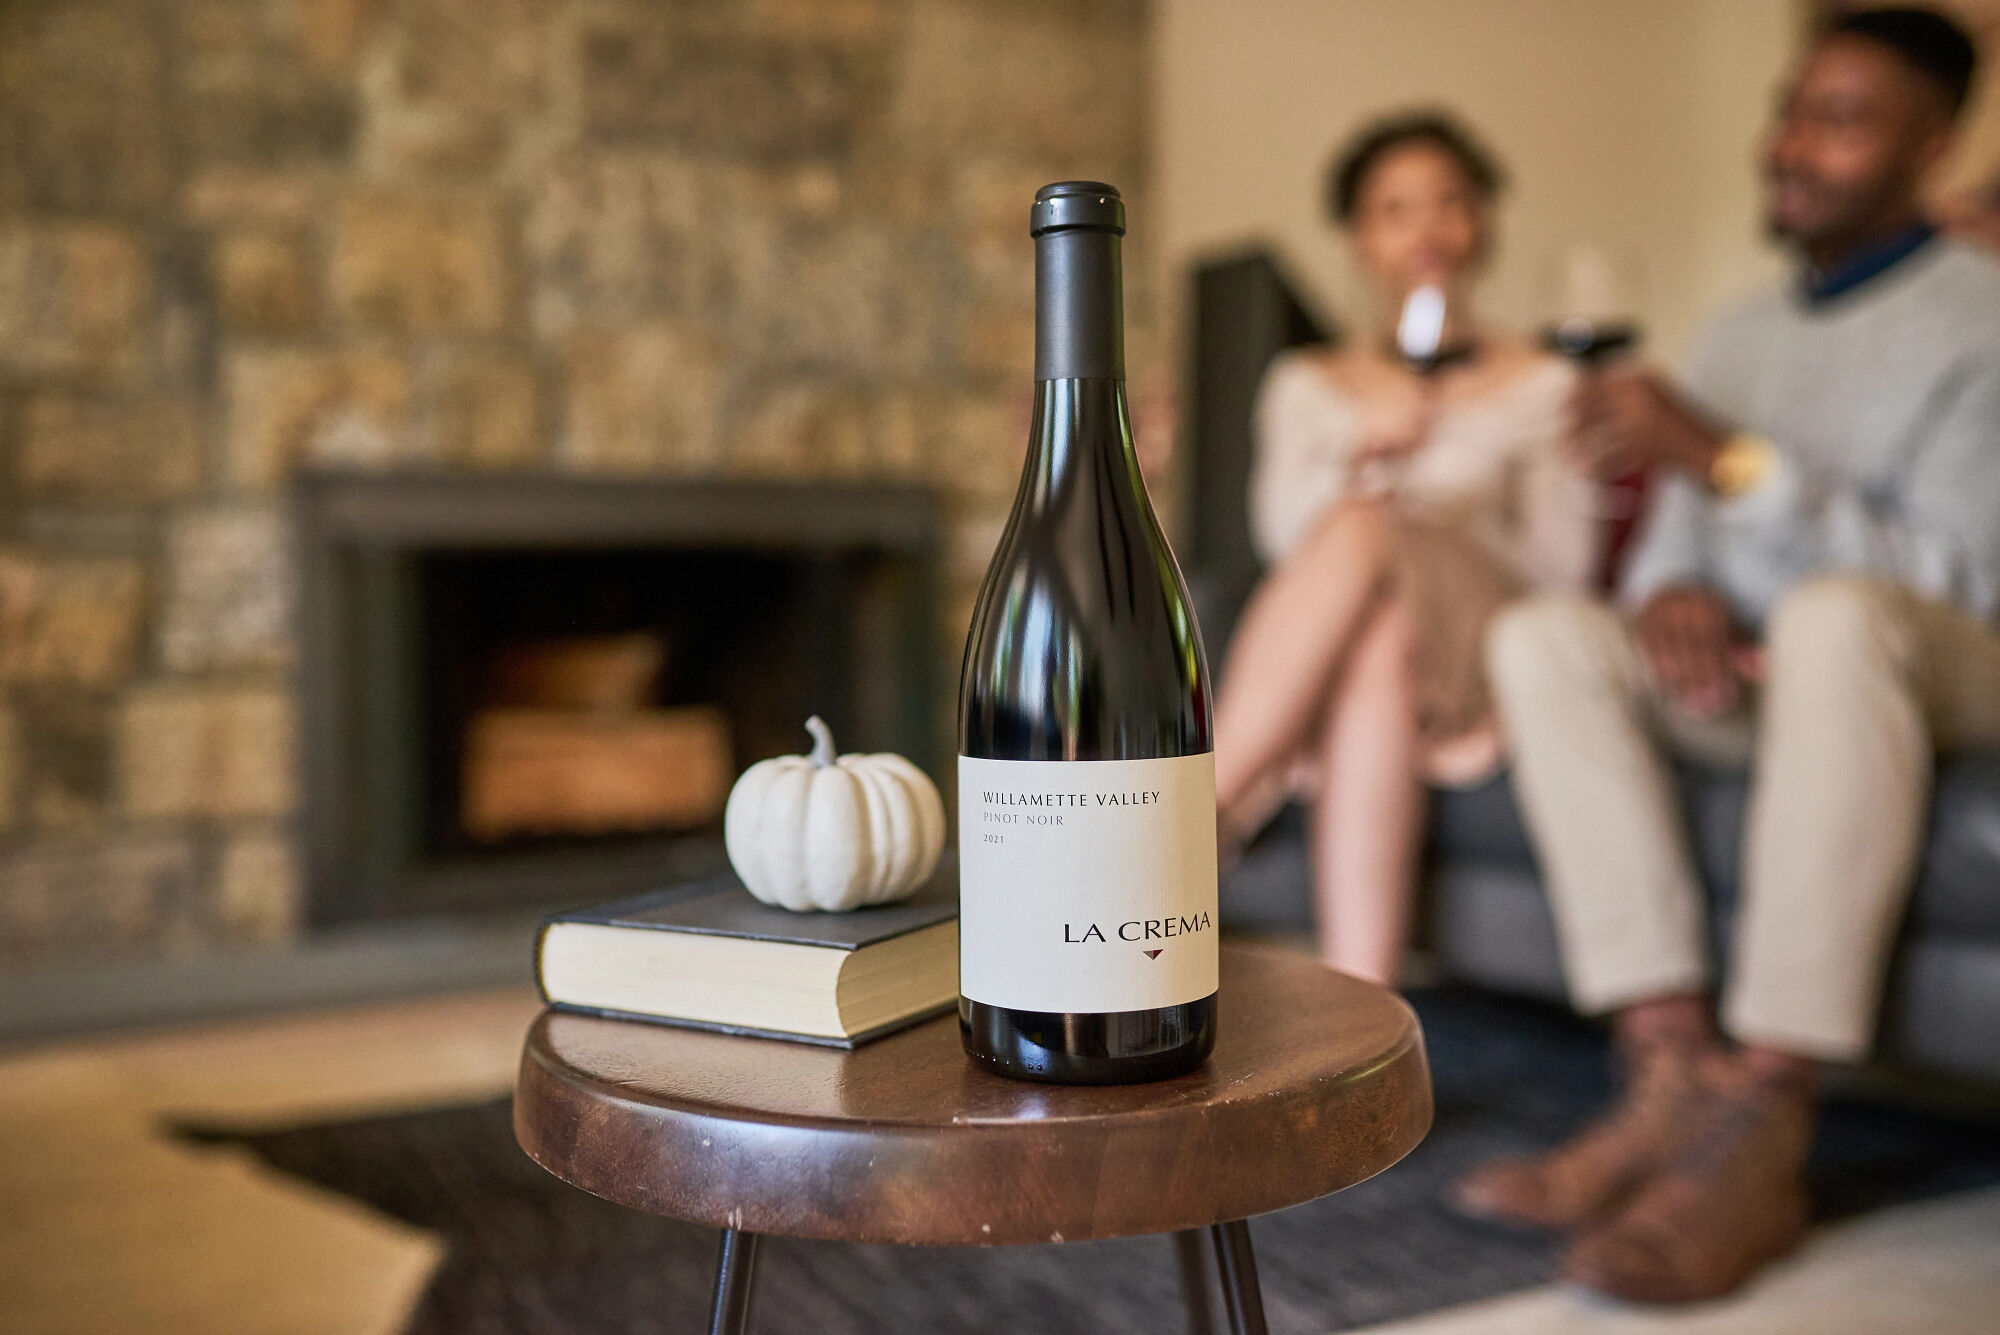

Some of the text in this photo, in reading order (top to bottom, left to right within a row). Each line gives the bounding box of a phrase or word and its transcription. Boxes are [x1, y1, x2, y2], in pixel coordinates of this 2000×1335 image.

[983, 791, 1161, 807] WILLAMETTE VALLEY
[983, 811, 1064, 826] PINOT NOIR
[983, 833, 1004, 844] 2021
[1064, 910, 1211, 943] LA CREMA
